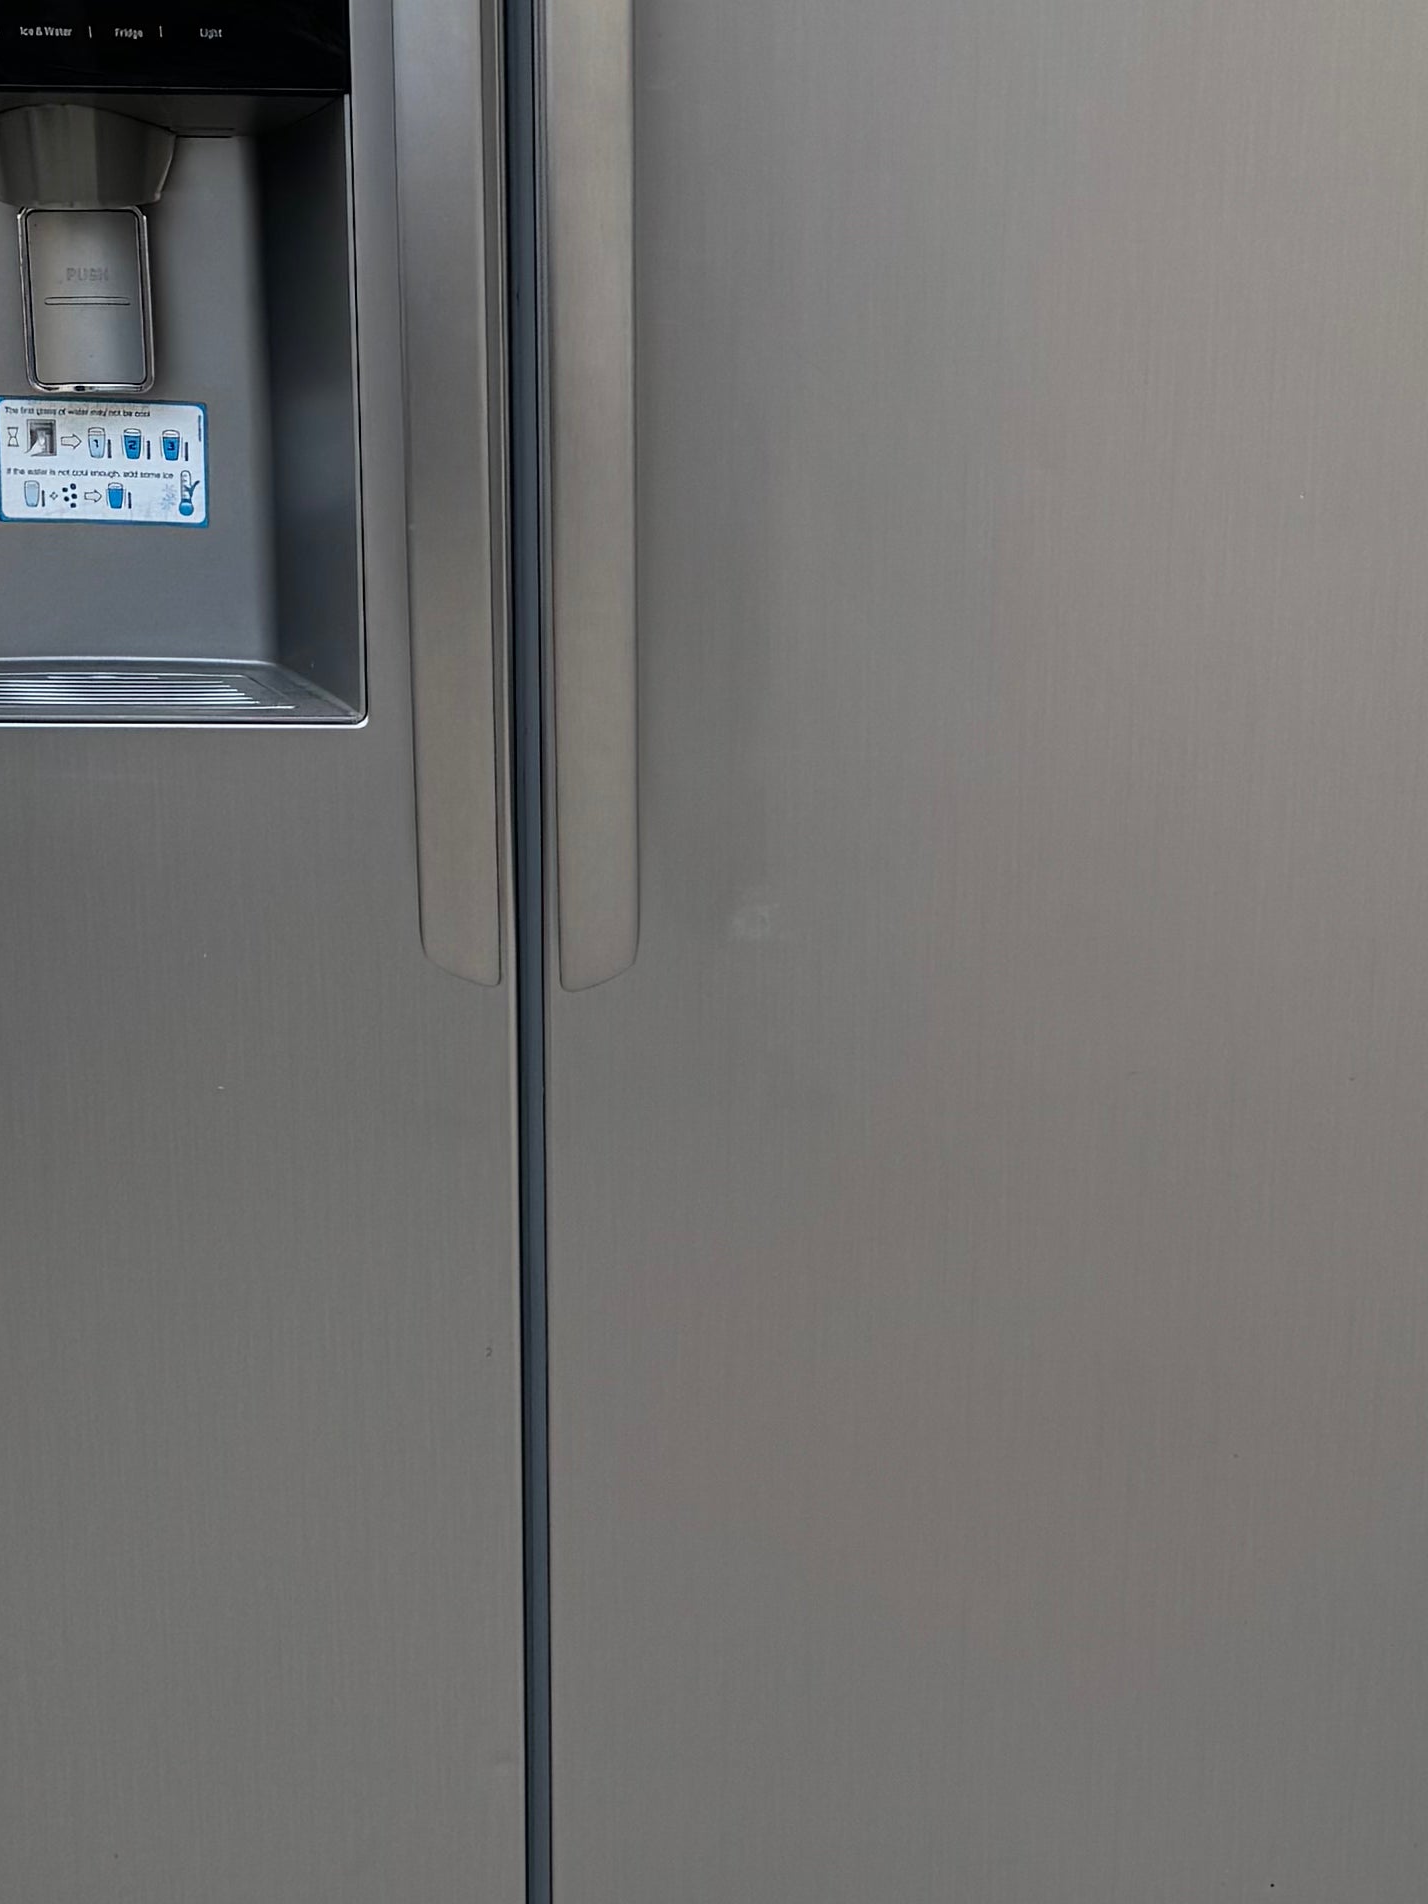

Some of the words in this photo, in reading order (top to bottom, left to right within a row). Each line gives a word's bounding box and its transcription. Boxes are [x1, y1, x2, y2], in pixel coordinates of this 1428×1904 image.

[20, 26, 34, 37] Ice
[44, 27, 73, 37] Water
[114, 27, 144, 39] Fridge
[199, 27, 223, 39] Light
